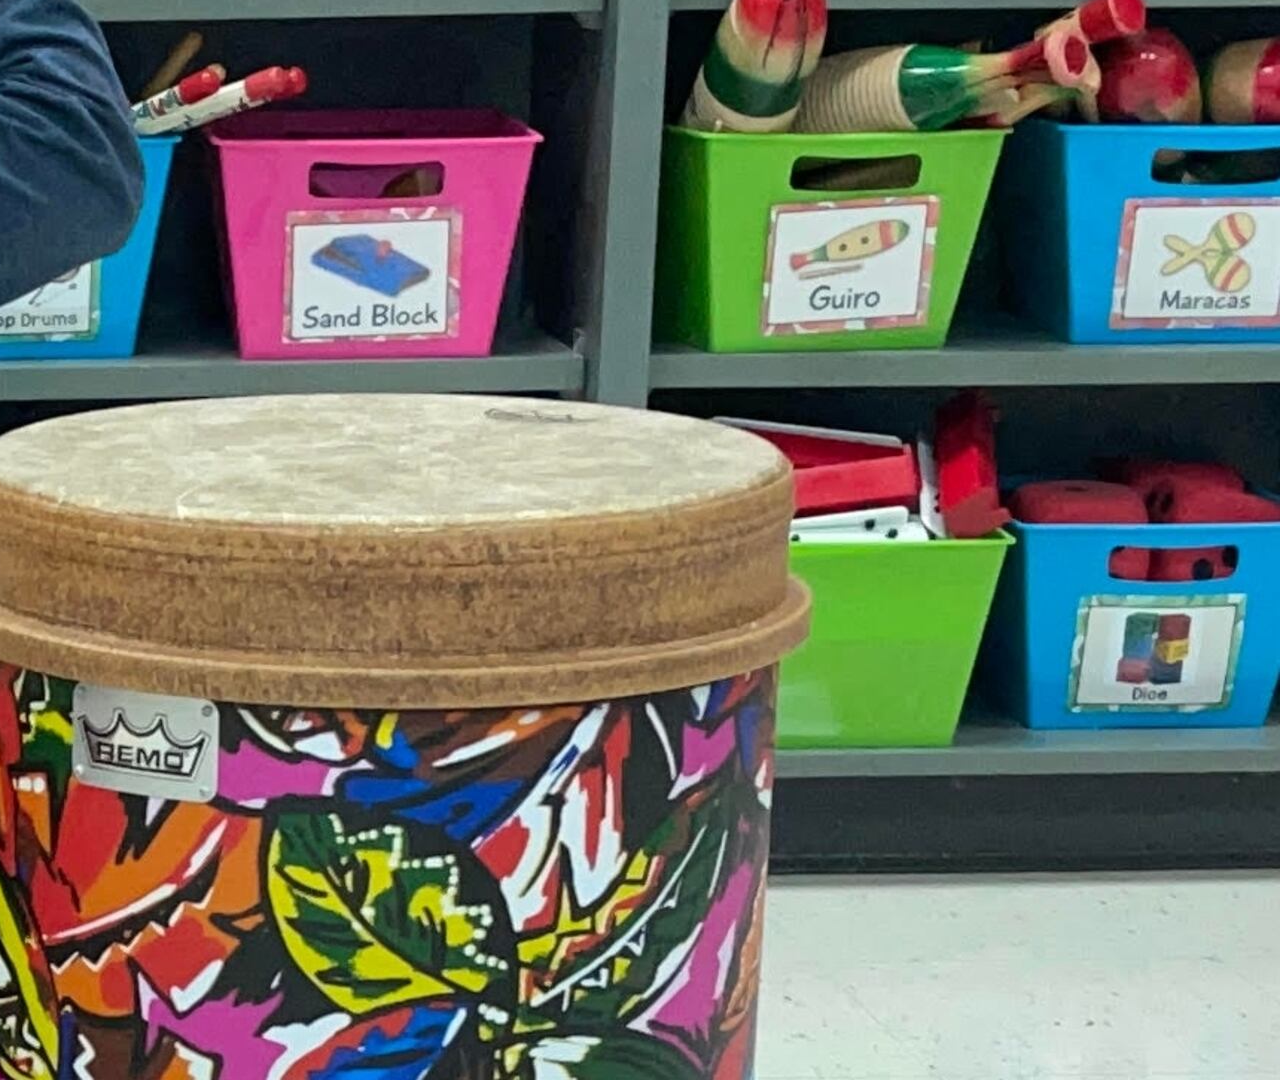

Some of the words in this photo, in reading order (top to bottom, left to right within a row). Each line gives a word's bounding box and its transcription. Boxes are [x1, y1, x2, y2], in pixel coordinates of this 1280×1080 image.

[809, 284, 881, 311] Guiro
[1159, 289, 1252, 310] Maracas
[20, 312, 79, 328] Drums
[302, 305, 361, 329] Sand
[371, 302, 439, 327] Block
[96, 741, 185, 770] REMO
